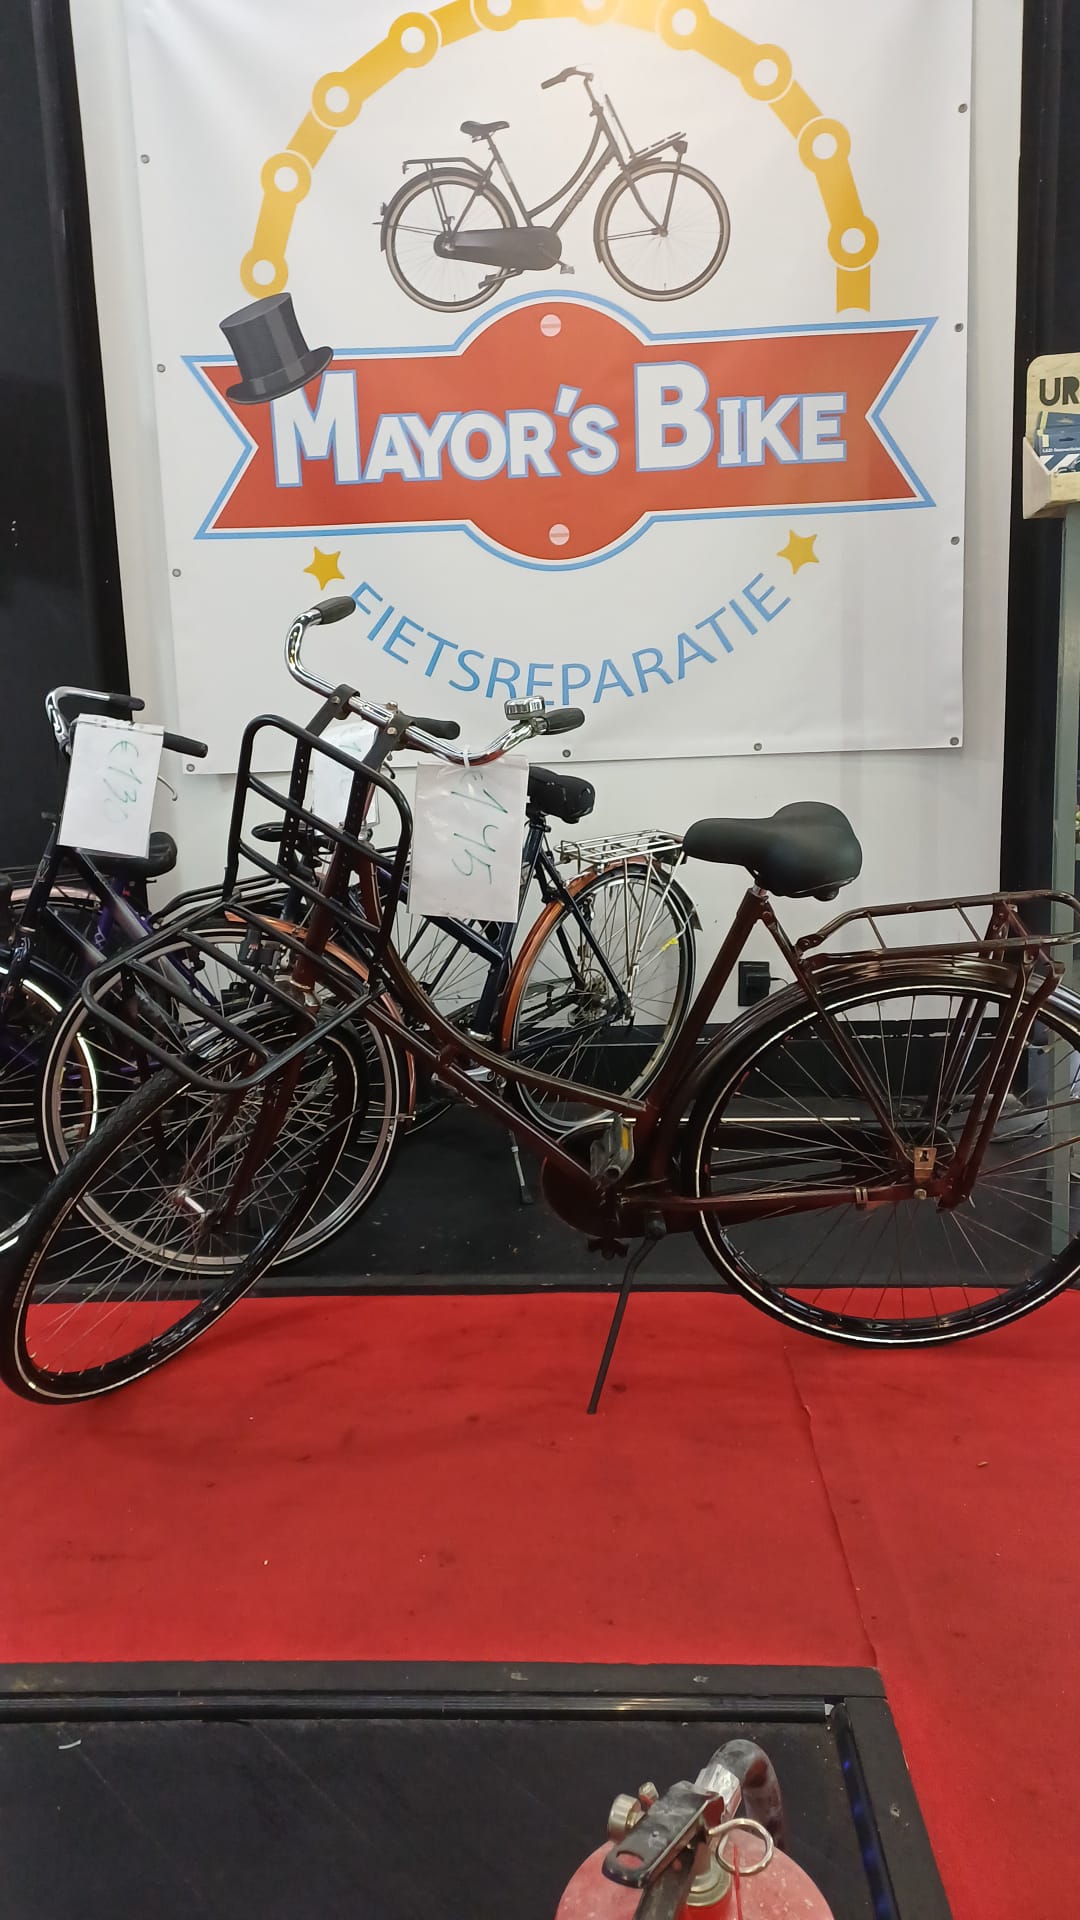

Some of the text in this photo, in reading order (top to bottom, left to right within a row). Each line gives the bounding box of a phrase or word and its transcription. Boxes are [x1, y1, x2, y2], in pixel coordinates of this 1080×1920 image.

[271, 359, 848, 487] MAYOR'S BIKE
[351, 572, 791, 706] FIETSREPARATIE
[450, 769, 509, 886] €145
